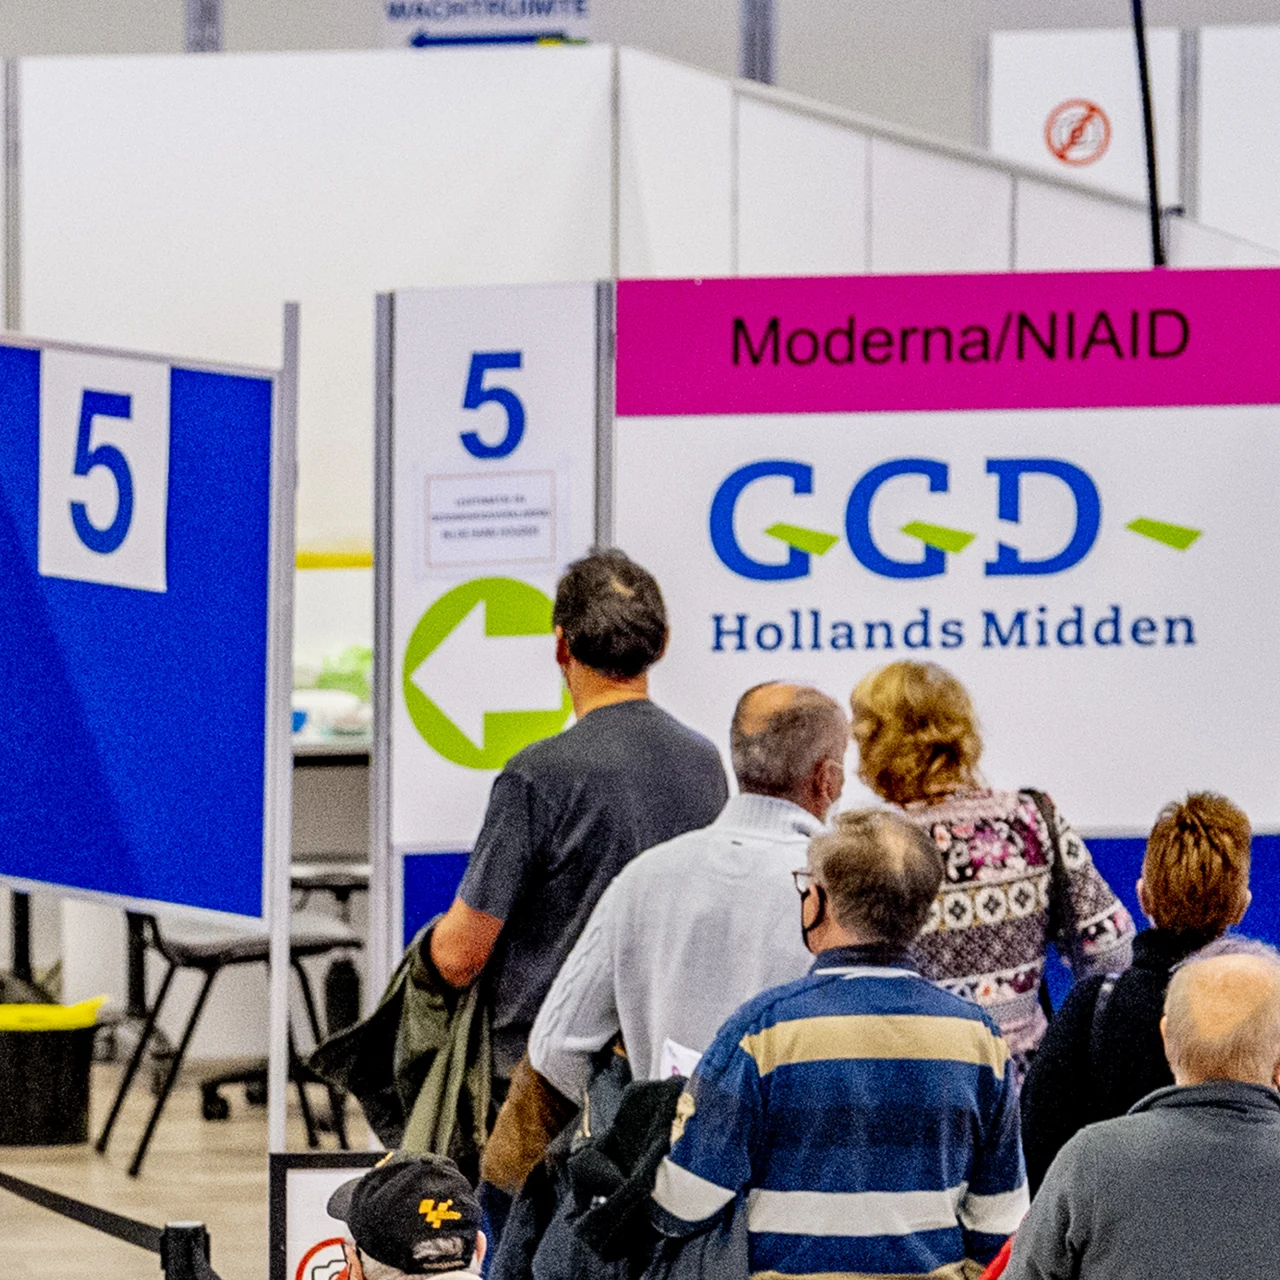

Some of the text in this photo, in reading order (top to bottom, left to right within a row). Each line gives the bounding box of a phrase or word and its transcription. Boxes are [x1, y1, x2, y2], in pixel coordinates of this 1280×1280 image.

[731, 308, 1190, 366] Moderna/NIAID
[460, 350, 526, 460] 5
[69, 388, 135, 555] 5
[708, 457, 1103, 582] GGD
[712, 605, 1197, 653] Hollands Midden
